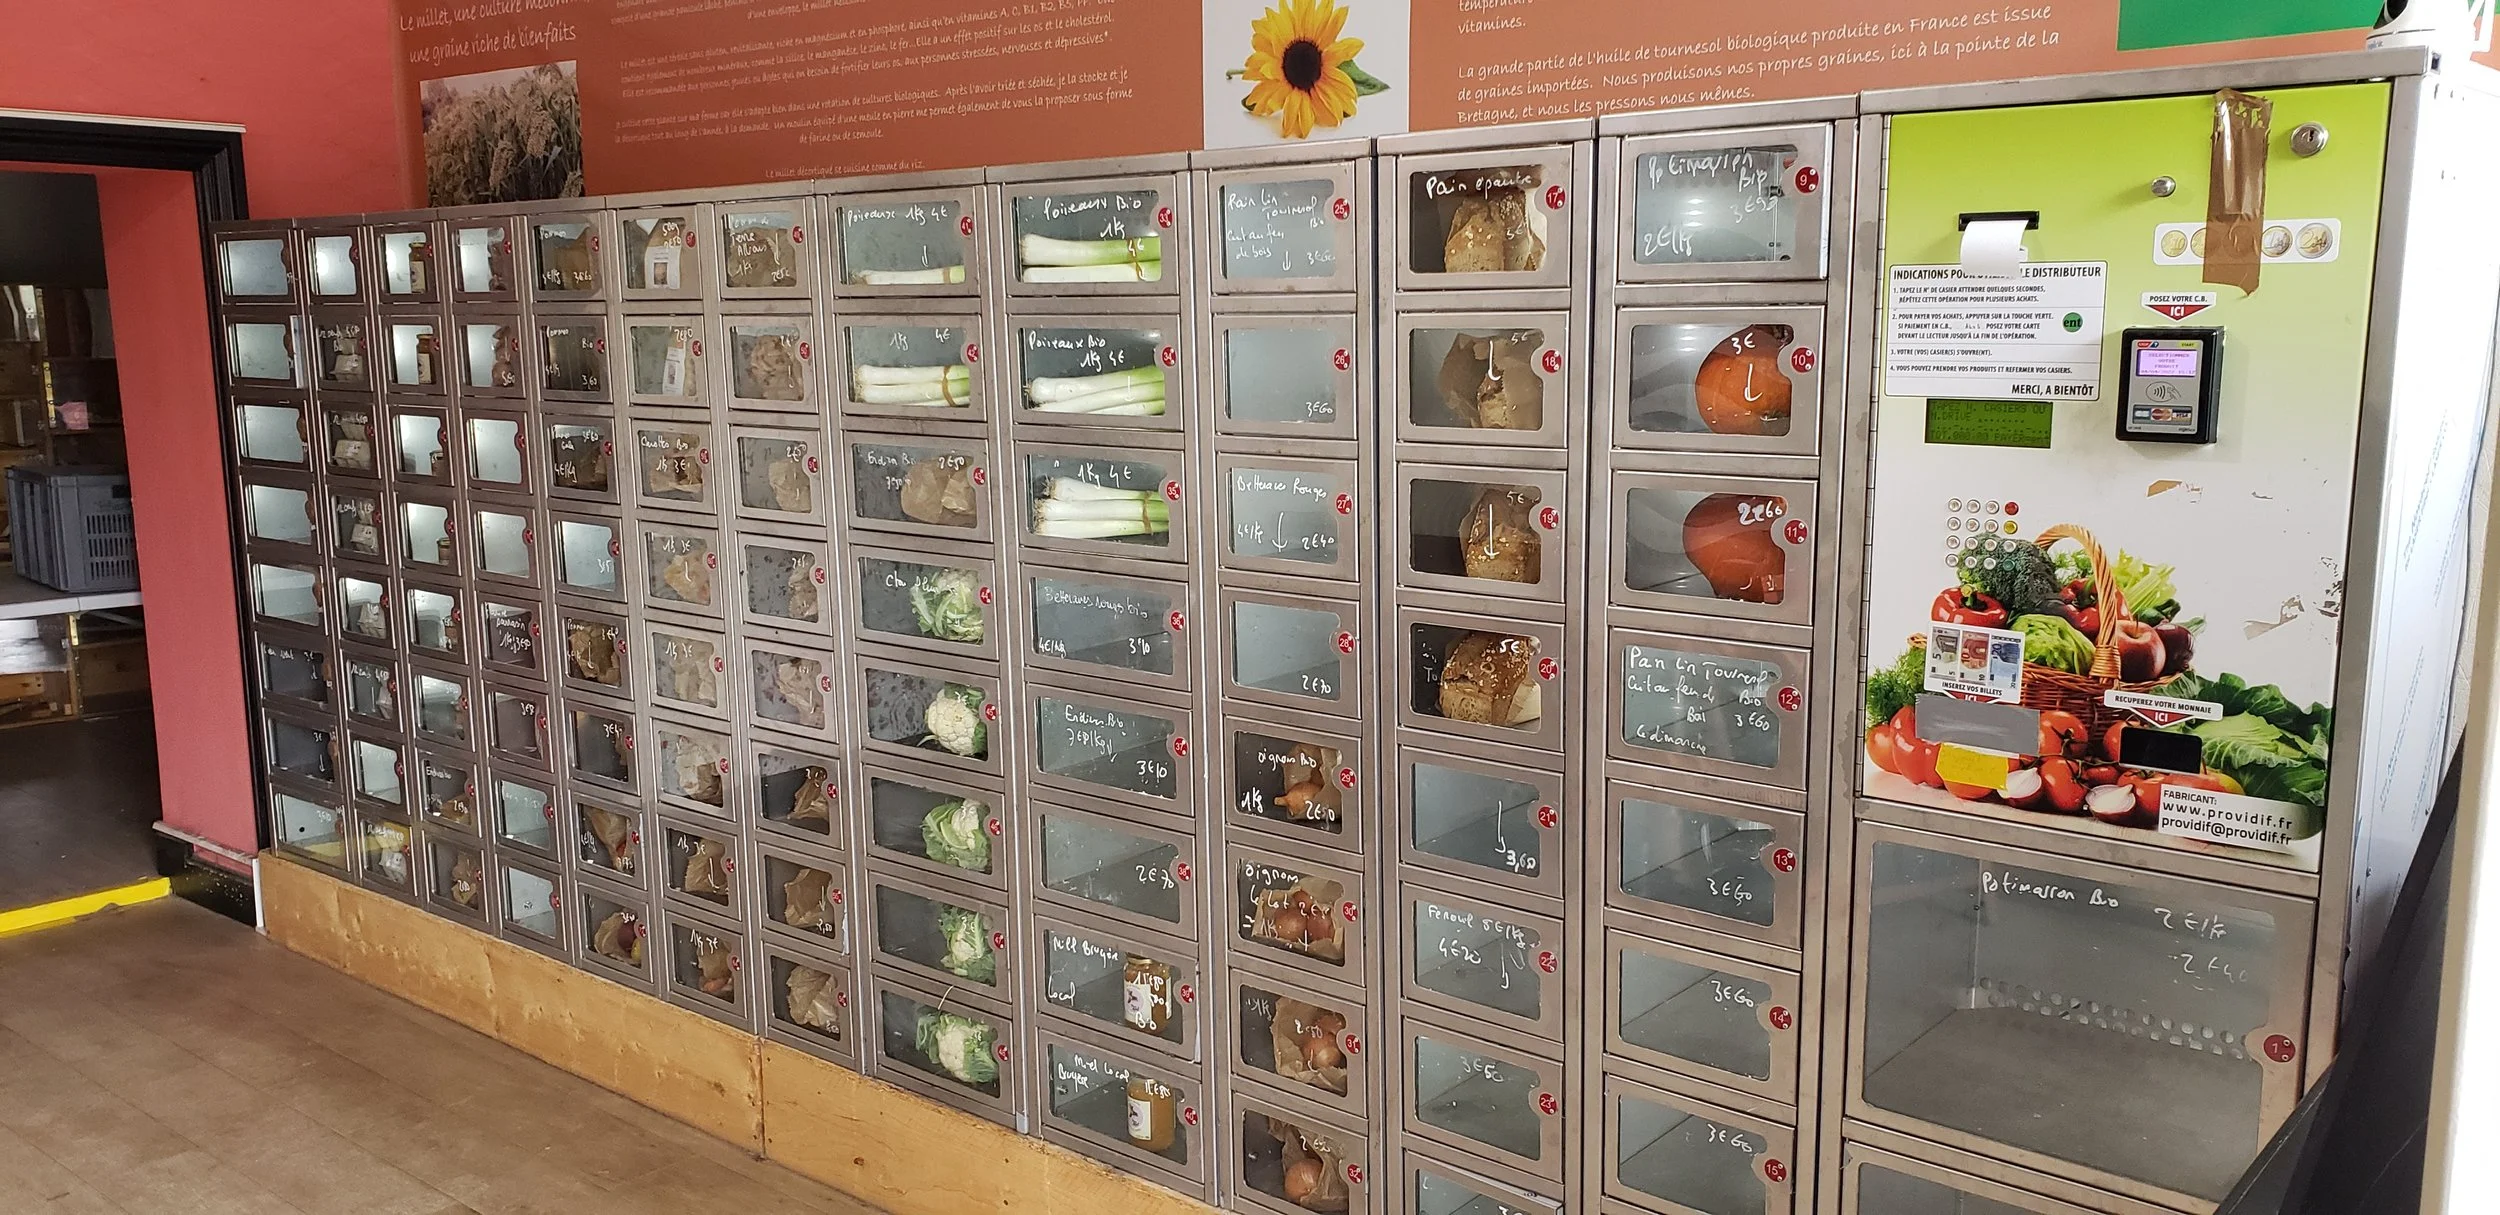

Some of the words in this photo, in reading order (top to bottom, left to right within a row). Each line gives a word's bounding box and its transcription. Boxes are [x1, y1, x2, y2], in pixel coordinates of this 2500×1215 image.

[400, 14, 414, 31] Le
[416, 9, 452, 29] millet,
[454, 7, 476, 23] une
[479, 0, 522, 19] culture
[908, 19, 930, 32] ainsi
[956, 10, 998, 25] vitamines
[953, 29, 972, 45] effet
[974, 23, 1001, 43] positif
[1065, 12, 1115, 29] cholestérol.
[1458, 16, 1526, 35] vitamines.
[409, 50, 430, 64] une
[432, 41, 471, 67] graine
[471, 35, 500, 55] riche
[502, 31, 517, 50] de
[519, 20, 577, 51] bienfaits
[1458, 65, 1474, 79] La
[1478, 60, 1524, 83] grande
[1527, 54, 1565, 76] partie
[1568, 51, 1583, 68] de
[1587, 46, 1631, 66] l'huile
[1634, 44, 1650, 61] de
[1654, 38, 1721, 58] tournesol
[1727, 31, 1807, 52] biologique
[1811, 19, 1879, 49] produite
[1884, 22, 1904, 35] en
[1909, 13, 1968, 33] France
[1973, 10, 1999, 25] est
[2004, 4, 2052, 22] issue
[921, 50, 960, 69] personnes
[961, 46, 999, 62] stressées,
[1001, 41, 1042, 55] nerveuses
[1458, 85, 1472, 101] de
[1474, 81, 1523, 106] graines
[1527, 75, 1593, 99] importées.
[1603, 72, 1638, 88] Nous
[1642, 63, 1722, 90] produisons
[1727, 60, 1754, 75] nos
[1758, 56, 1813, 78] propres
[1818, 48, 1885, 72] graines,
[1891, 43, 1912, 60] ici
[1917, 41, 1928, 56] à
[1933, 38, 1950, 56] la
[1955, 34, 2010, 60] pointe
[2016, 32, 2036, 48] de
[2041, 29, 2060, 46] la
[945, 81, 968, 98] Après
[1028, 74, 1056, 89] séchée,
[1078, 67, 1107, 83] stocke
[957, 98, 1000, 117] également
[1013, 96, 1032, 109] vous
[1045, 93, 1080, 110] proposer
[1082, 89, 1103, 102] sous
[1106, 86, 1133, 104] forme
[1457, 105, 1519, 125] Bretagne,
[1522, 102, 1534, 118] et
[1537, 101, 1570, 117] nous
[1573, 97, 1592, 114] les
[1596, 92, 1656, 119] pressons
[1660, 90, 1695, 106] nous
[1699, 85, 1755, 102] mêmes.
[1426, 174, 1467, 199] Pain
[1799, 174, 1808, 187] 9
[1116, 195, 1142, 211] Bio
[1228, 193, 1256, 210] Pain
[1547, 192, 1558, 203] 17
[1334, 204, 1345, 215] 25
[1159, 213, 1168, 223] 33
[1893, 269, 1949, 280] INDICATIONS
[2032, 266, 2101, 279] DISTRIBUTEUR
[1900, 286, 1915, 294] TAPEZ
[1986, 286, 2014, 294] QUELQUES
[2015, 285, 2046, 293] SECONDES,
[2149, 295, 2171, 303] POSEZ
[2172, 295, 2193, 303] VOTRE
[1943, 313, 1965, 321] ACHATS,
[2170, 306, 2185, 317] ICI
[2063, 316, 2082, 329] ent
[1088, 334, 1106, 349] Bio
[1162, 352, 1173, 362] 34
[1335, 355, 1345, 365] 26
[1545, 356, 1555, 367] 18
[1792, 354, 1806, 367] 10
[2011, 384, 2043, 398] MERCI,
[2045, 385, 2052, 396] A
[2054, 383, 2094, 396] BIENTÔT
[1167, 486, 1177, 496] 35
[1293, 476, 1328, 503] Rouges
[1337, 500, 1347, 510] 27
[1542, 512, 1553, 524] 19
[1786, 526, 1798, 538] 11
[1339, 637, 1349, 648] 28
[1540, 663, 1552, 674] 20
[1941, 681, 1965, 691] INSEREZ
[1966, 685, 1979, 693] VOS
[1980, 687, 2003, 697] BILLETS
[1738, 689, 1762, 707] Bio
[1780, 693, 1792, 705] 12
[2114, 694, 2153, 707] RECUPEREZ
[2154, 700, 2176, 710] VOTRE
[2177, 703, 2212, 714] MONNAIE
[2154, 711, 2169, 723] ICI
[1341, 773, 1351, 784] 29
[2163, 789, 2217, 806] FABRICANT:
[1539, 811, 1551, 823] 21
[2162, 801, 2293, 831] www.providif.fr
[2161, 815, 2292, 846] providif@providif.fr
[1775, 854, 1788, 866] 13
[1541, 956, 1553, 968] 22
[1772, 1011, 1785, 1024] 14
[1540, 1096, 1551, 1109] 23
[1766, 1164, 1779, 1176] 15
